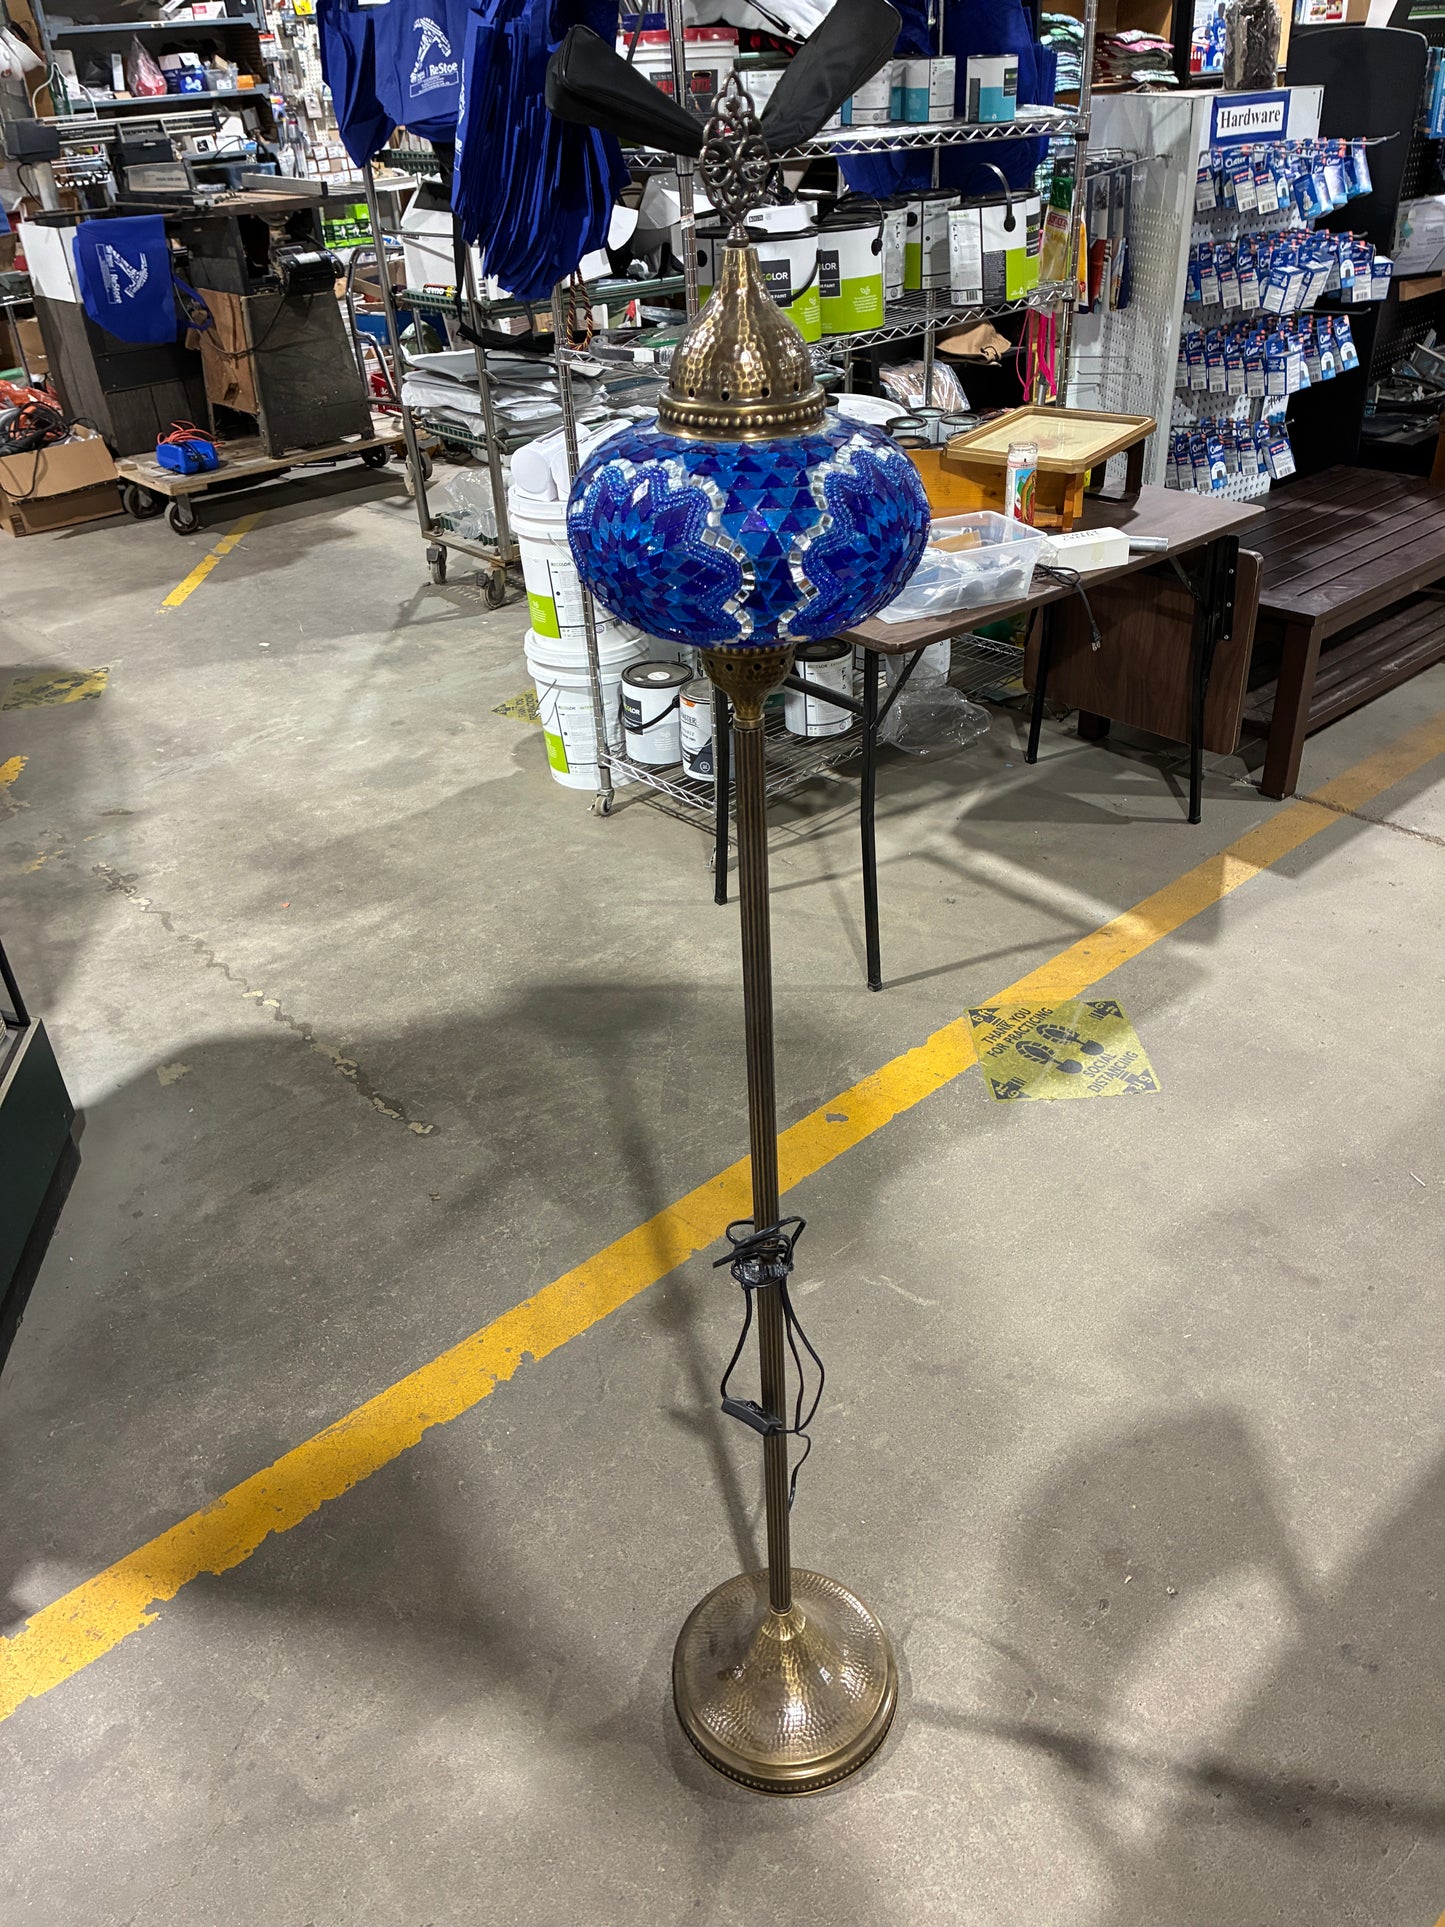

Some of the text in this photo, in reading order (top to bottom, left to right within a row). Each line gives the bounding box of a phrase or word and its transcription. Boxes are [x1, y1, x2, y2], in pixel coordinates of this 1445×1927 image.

[1221, 107, 1281, 129] Hardware
[1225, 156, 1247, 168] Cutter
[1326, 158, 1340, 167] Cutter
[1209, 443, 1223, 454] Cutter
[981, 1007, 1032, 1045] THANK YOU
[986, 1007, 1054, 1059] FOR PRACTICING
[1083, 1051, 1117, 1078] SOCIAL
[1087, 1051, 1140, 1093] DISTANCING
